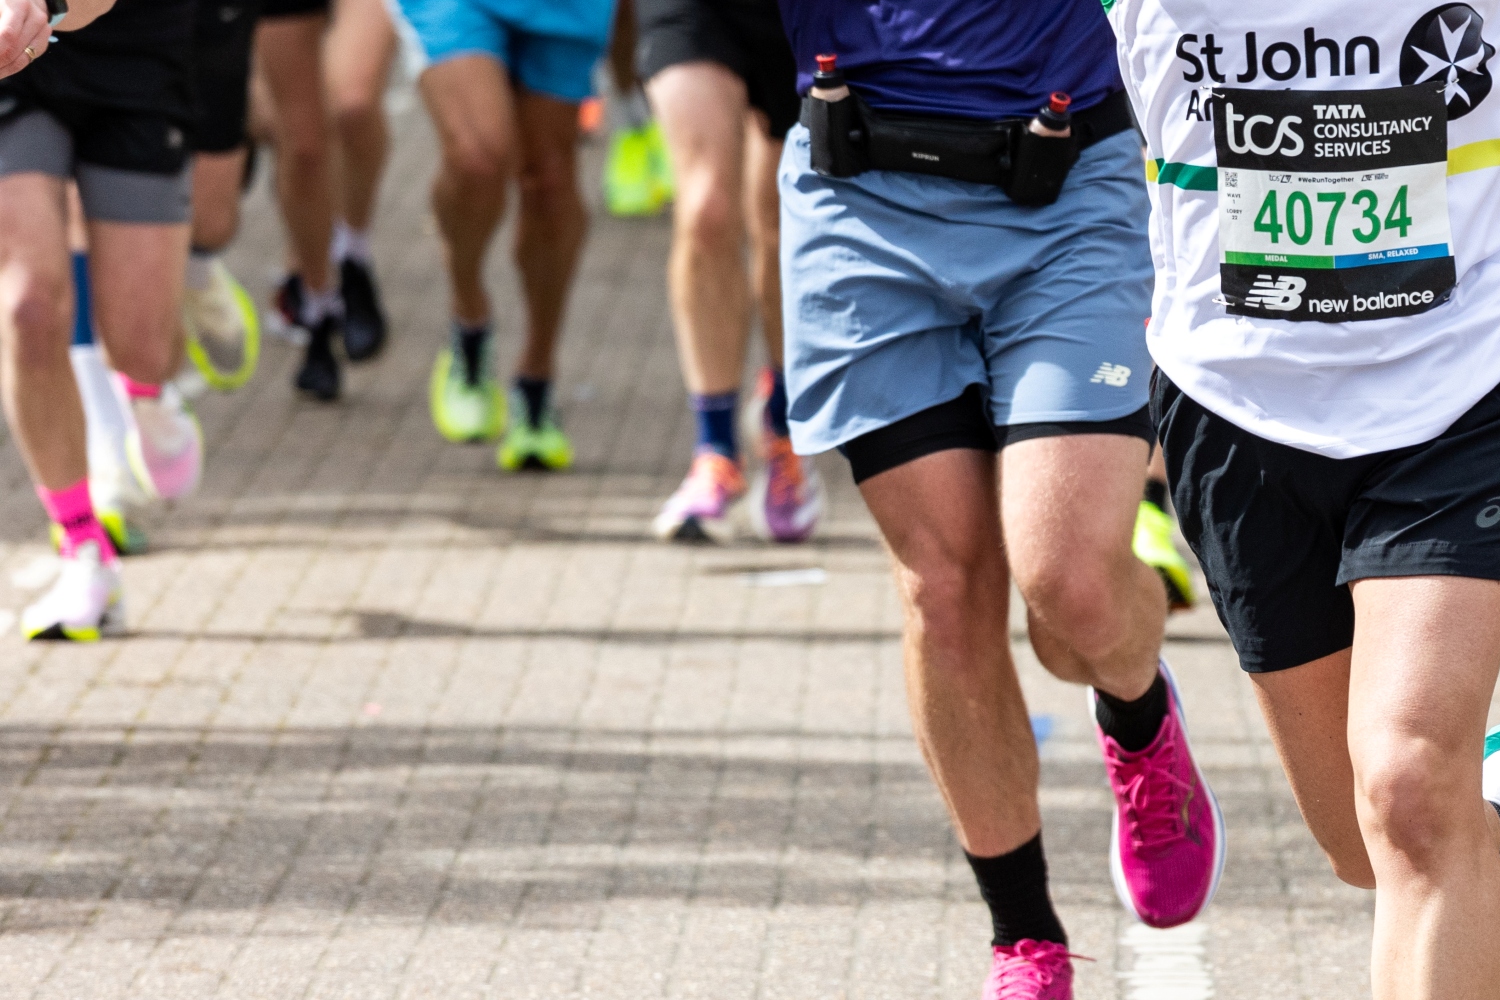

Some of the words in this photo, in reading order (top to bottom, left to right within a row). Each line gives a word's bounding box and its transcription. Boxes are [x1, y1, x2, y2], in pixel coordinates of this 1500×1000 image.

[1175, 33, 1226, 84] St
[1236, 26, 1381, 83] John
[1313, 104, 1366, 120] TATA
[1226, 102, 1305, 158] tcs
[1313, 116, 1433, 139] CONSULTANCY
[1314, 139, 1392, 158] SERVICES
[1253, 184, 1413, 246] 40734
[1264, 254, 1288, 263] MEDAL
[1367, 252, 1386, 260] SMA,
[1386, 247, 1419, 258] RELAXED
[1308, 298, 1349, 313] new
[1353, 290, 1435, 312] balance
